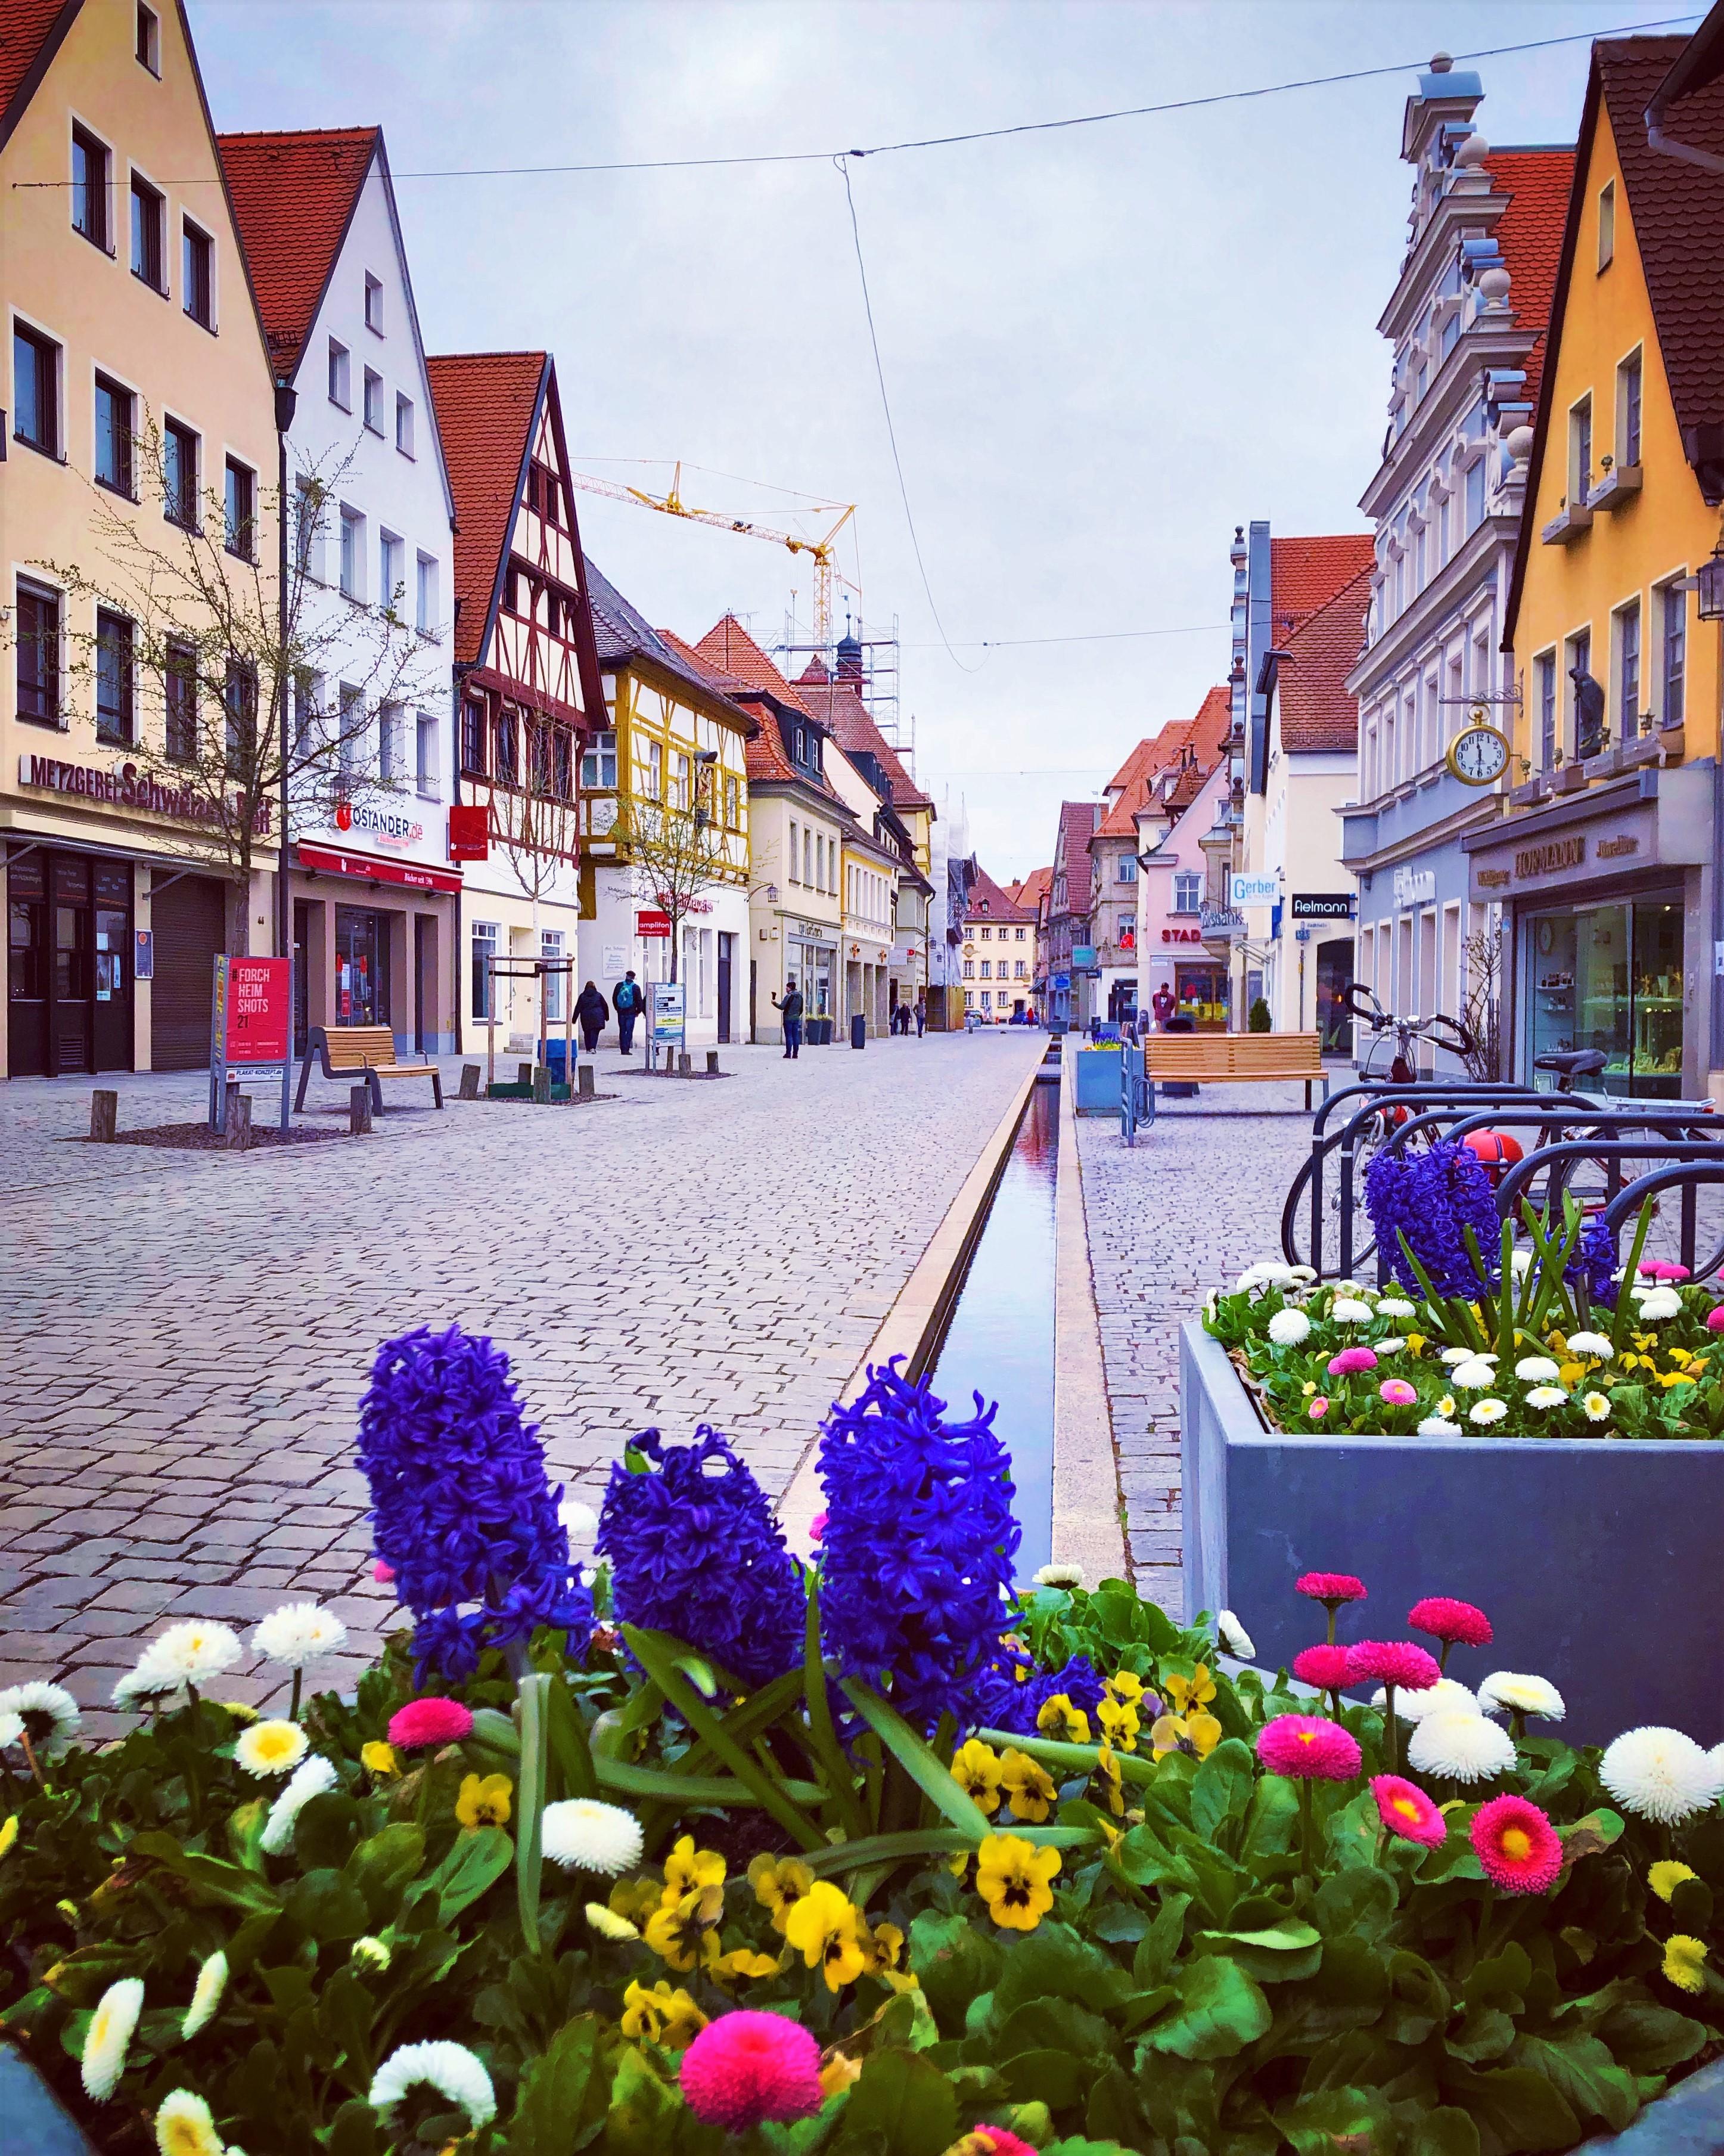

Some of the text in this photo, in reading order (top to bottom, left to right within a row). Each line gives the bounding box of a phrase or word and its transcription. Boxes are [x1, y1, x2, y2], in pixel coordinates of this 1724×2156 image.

[1477, 733, 1484, 741] 12
[1487, 735, 1490, 743] 1
[1461, 743, 1468, 751] 10
[1493, 741, 1498, 749] 2
[1458, 752, 1464, 761] 9
[1496, 750, 1502, 759] 3
[1461, 761, 1466, 770] 8
[1468, 767, 1474, 775] 7
[1477, 768, 1483, 777] 6
[1486, 766, 1492, 775] 5
[30, 754, 117, 804] METZGEREI
[352, 806, 424, 840] OSIANDER.de
[1234, 879, 1276, 899] Gerber
[1294, 899, 1347, 913] fielmann
[638, 921, 670, 930] amplifon
[232, 967, 270, 982] #FORCH
[238, 984, 263, 998] HEIM
[237, 998, 269, 1013] SHOTS
[237, 1015, 248, 1029] 21
